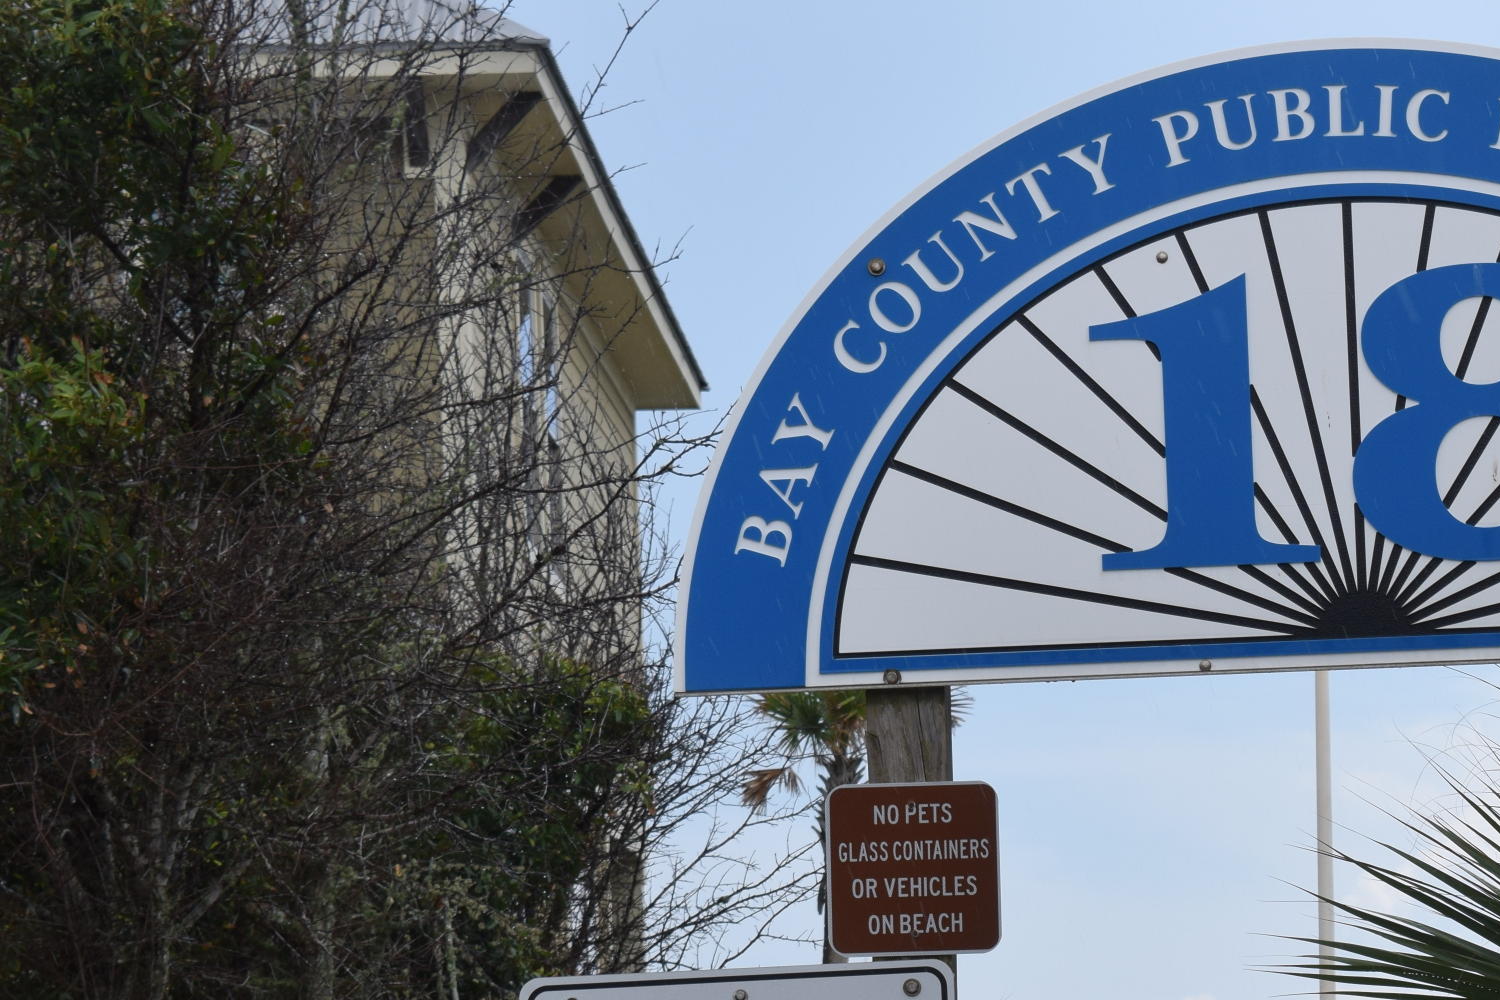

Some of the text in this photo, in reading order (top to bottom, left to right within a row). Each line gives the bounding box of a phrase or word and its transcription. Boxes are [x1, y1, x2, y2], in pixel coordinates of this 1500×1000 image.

[734, 394, 834, 566] BAY
[834, 134, 1116, 373] COUNTY
[1152, 85, 1449, 167] PUBLIC
[873, 803, 952, 825] NO PETS
[838, 838, 989, 862] GLASS CONTAINERS
[852, 876, 977, 898] OR VEHICLES
[868, 912, 963, 935] ON BEACH
